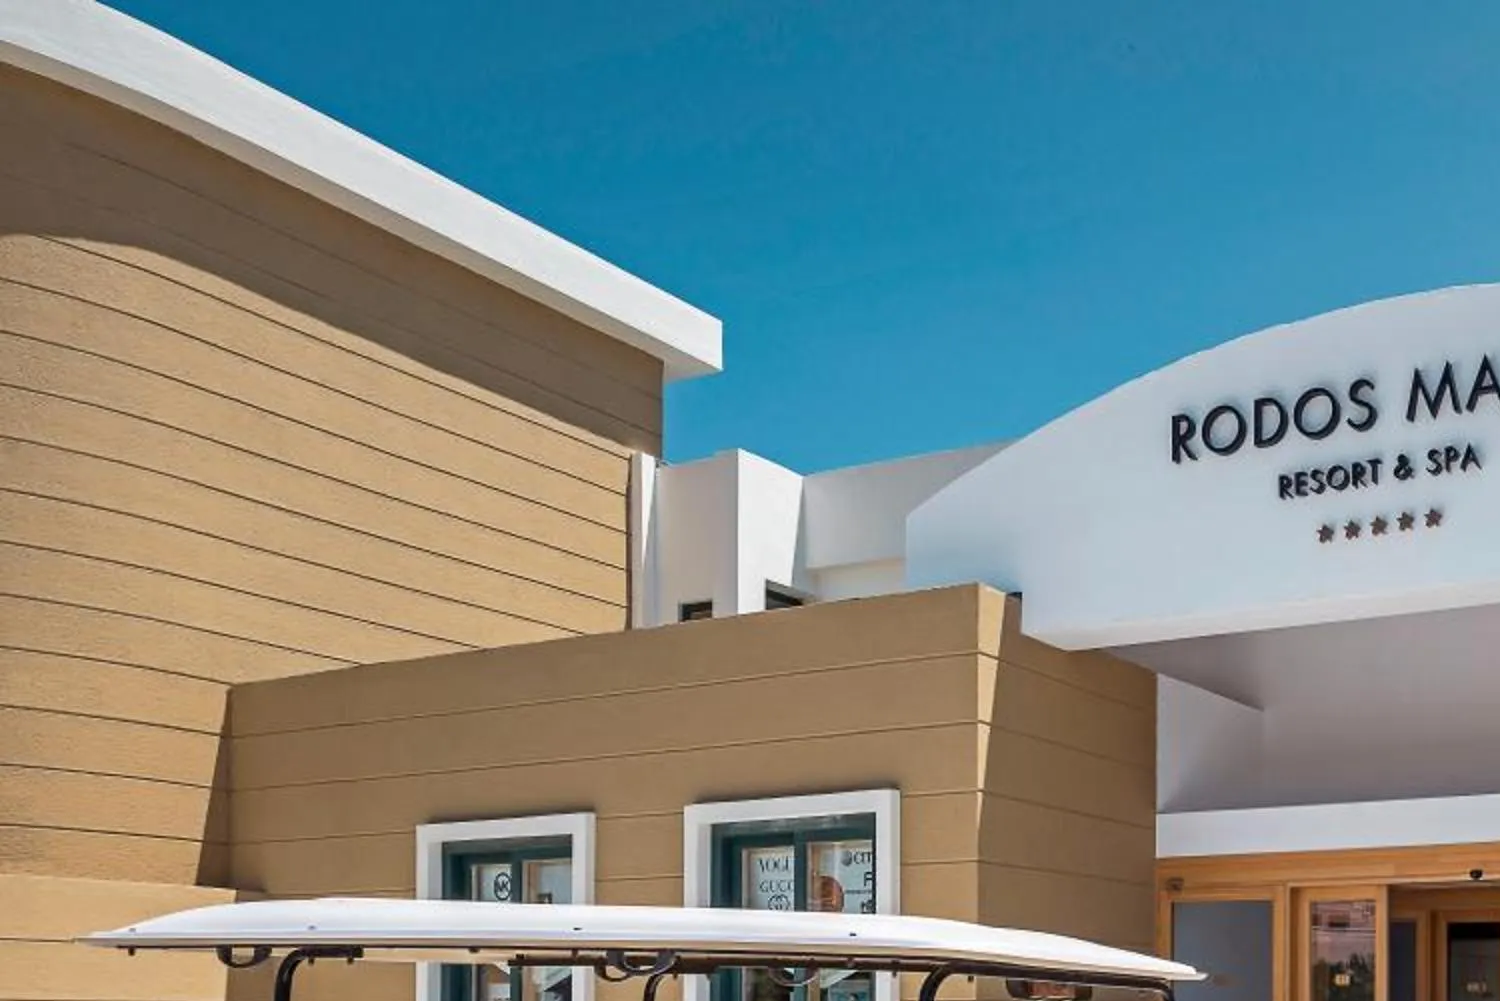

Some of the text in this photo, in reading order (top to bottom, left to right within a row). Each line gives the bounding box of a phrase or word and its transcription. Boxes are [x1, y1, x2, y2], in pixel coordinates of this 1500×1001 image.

[1171, 378, 1379, 464] RODOS
[1279, 443, 1483, 501] RESORT & SPA
